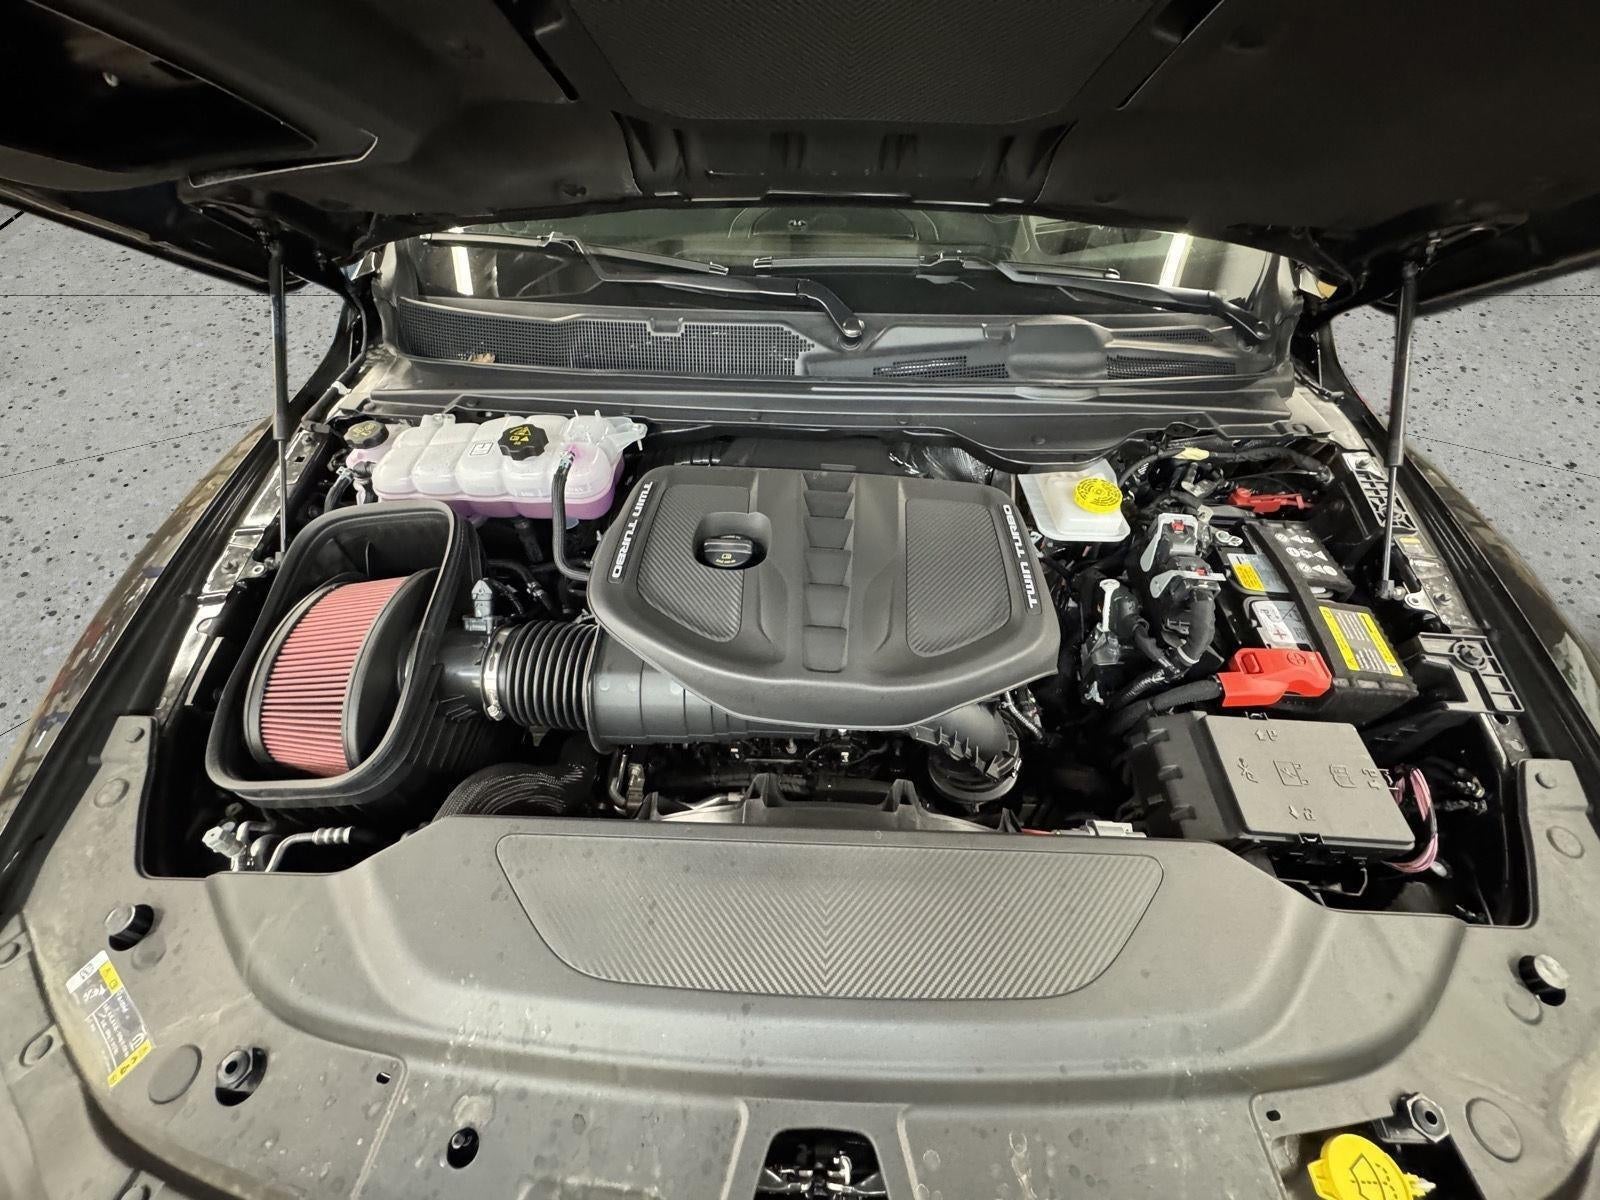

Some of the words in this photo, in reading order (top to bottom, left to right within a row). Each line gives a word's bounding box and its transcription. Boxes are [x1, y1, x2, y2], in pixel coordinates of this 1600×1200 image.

[632, 481, 653, 517] TWIN
[612, 519, 638, 578] TURBO
[1003, 504, 1025, 558] TURBO
[1020, 561, 1038, 609] TWIN
